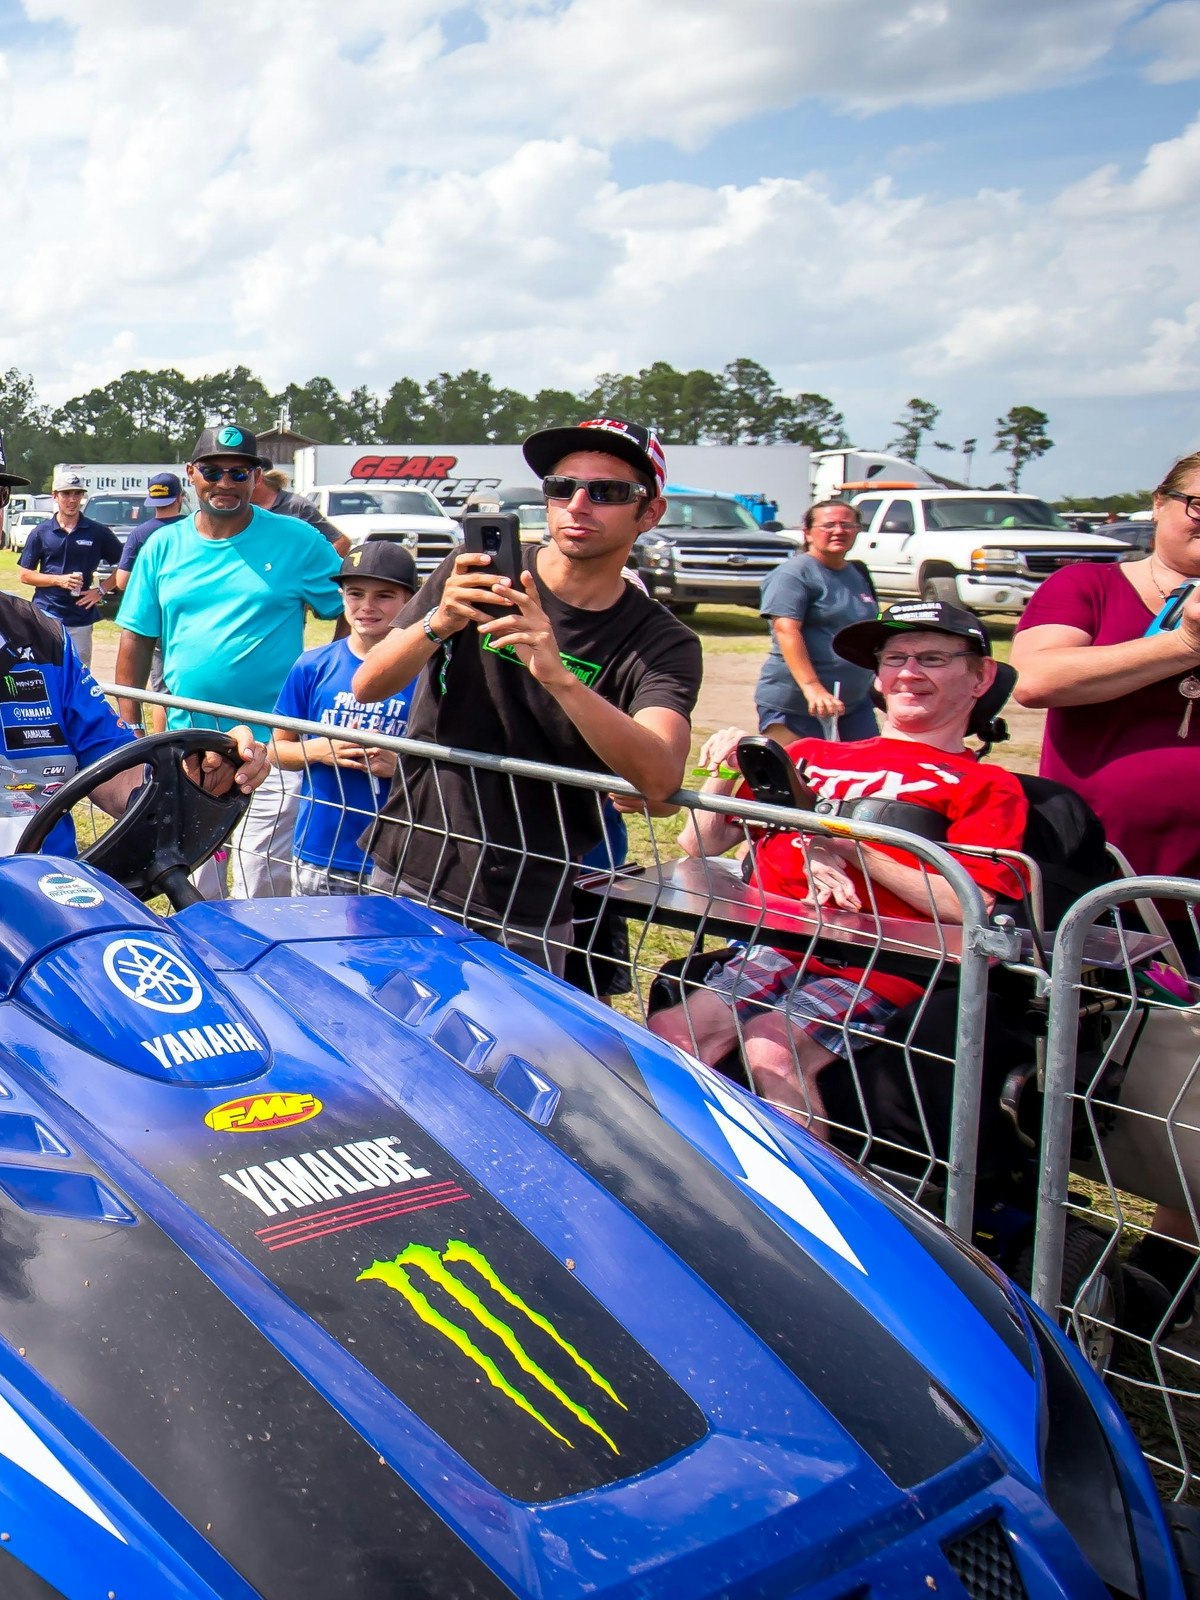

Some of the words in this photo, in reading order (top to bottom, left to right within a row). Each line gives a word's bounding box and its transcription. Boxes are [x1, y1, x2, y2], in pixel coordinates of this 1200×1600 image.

[350, 455, 458, 479] GEAR
[96, 477, 117, 490] Lite
[122, 477, 142, 491] Lite
[21, 706, 52, 718] YAMAHA
[386, 698, 406, 718] IT
[320, 708, 338, 727] AT
[339, 710, 368, 731] THE
[368, 715, 409, 738] PLAT
[140, 1022, 264, 1070] YAMAHA
[212, 1093, 316, 1132] FMF
